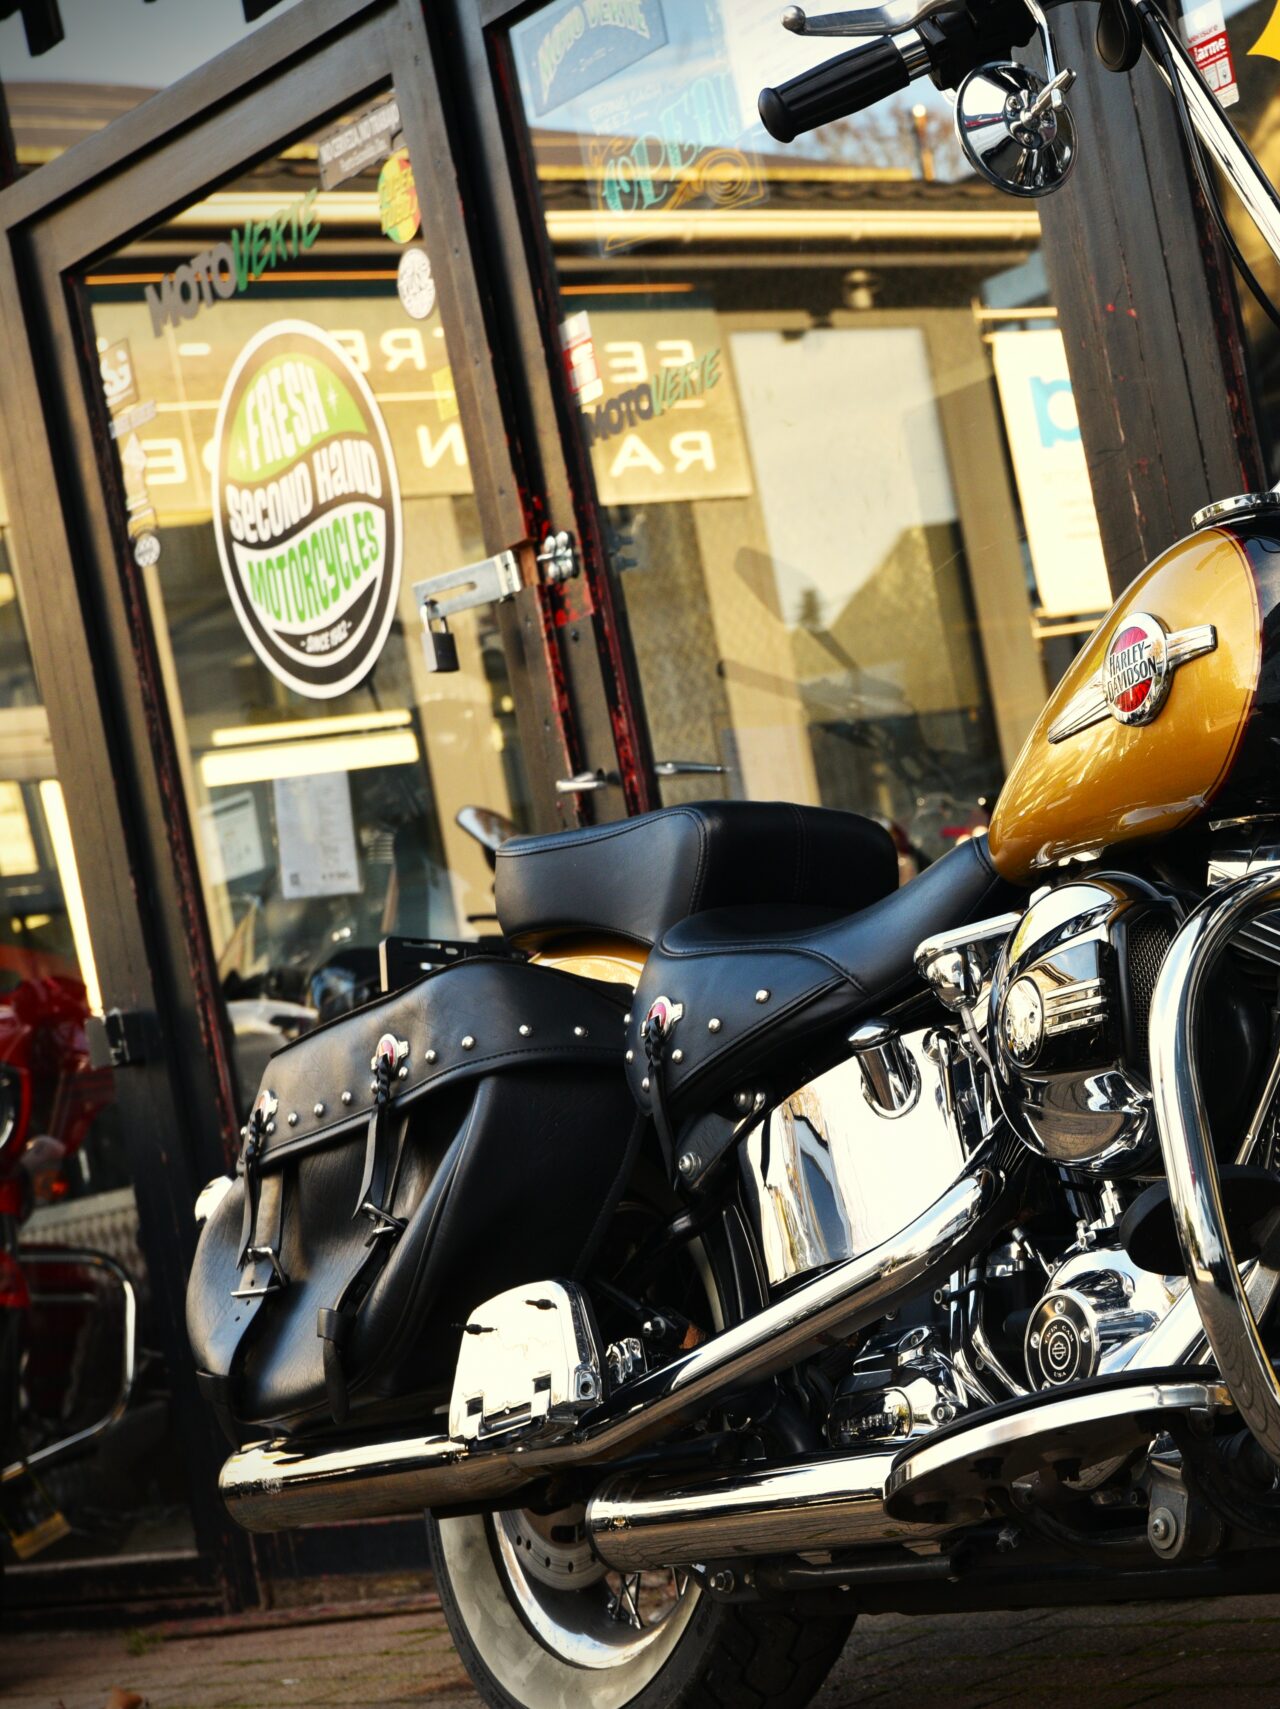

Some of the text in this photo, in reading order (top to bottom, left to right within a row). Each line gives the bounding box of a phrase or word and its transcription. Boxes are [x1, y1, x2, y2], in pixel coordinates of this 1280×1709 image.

[245, 360, 330, 472] FRESH
[247, 510, 380, 623] MOTORCYCLES
[1107, 655, 1157, 702] DAVIDSON
[1109, 640, 1151, 678] HARLEY-
[1044, 1324, 1075, 1345] TWIN CAM
